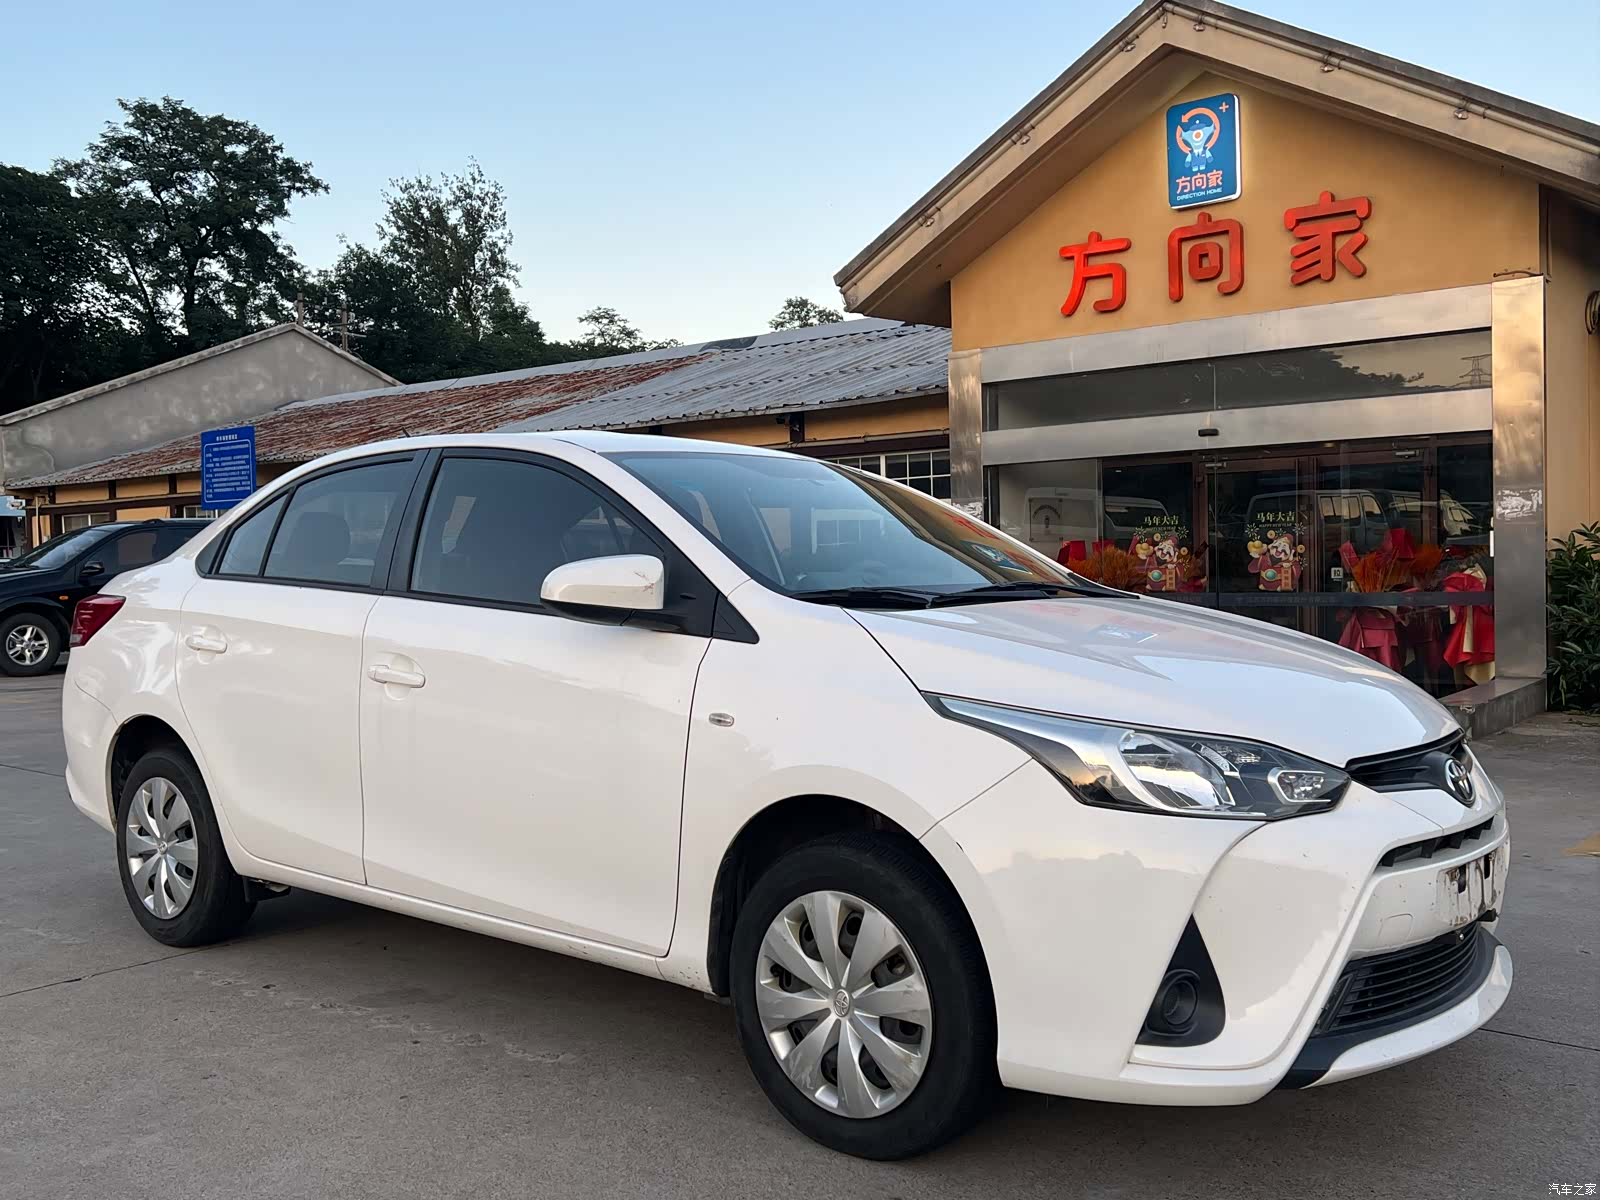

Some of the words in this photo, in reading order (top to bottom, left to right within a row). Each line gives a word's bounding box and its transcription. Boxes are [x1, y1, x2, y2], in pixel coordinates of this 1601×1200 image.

[1176, 169, 1223, 194] 方向家
[1176, 190, 1206, 201] DIRECTION
[1206, 187, 1223, 195] HOME
[1059, 191, 1372, 317] 方向家
[1144, 515, 1179, 526] 马年大吉
[1256, 511, 1295, 523] 马年大吉
